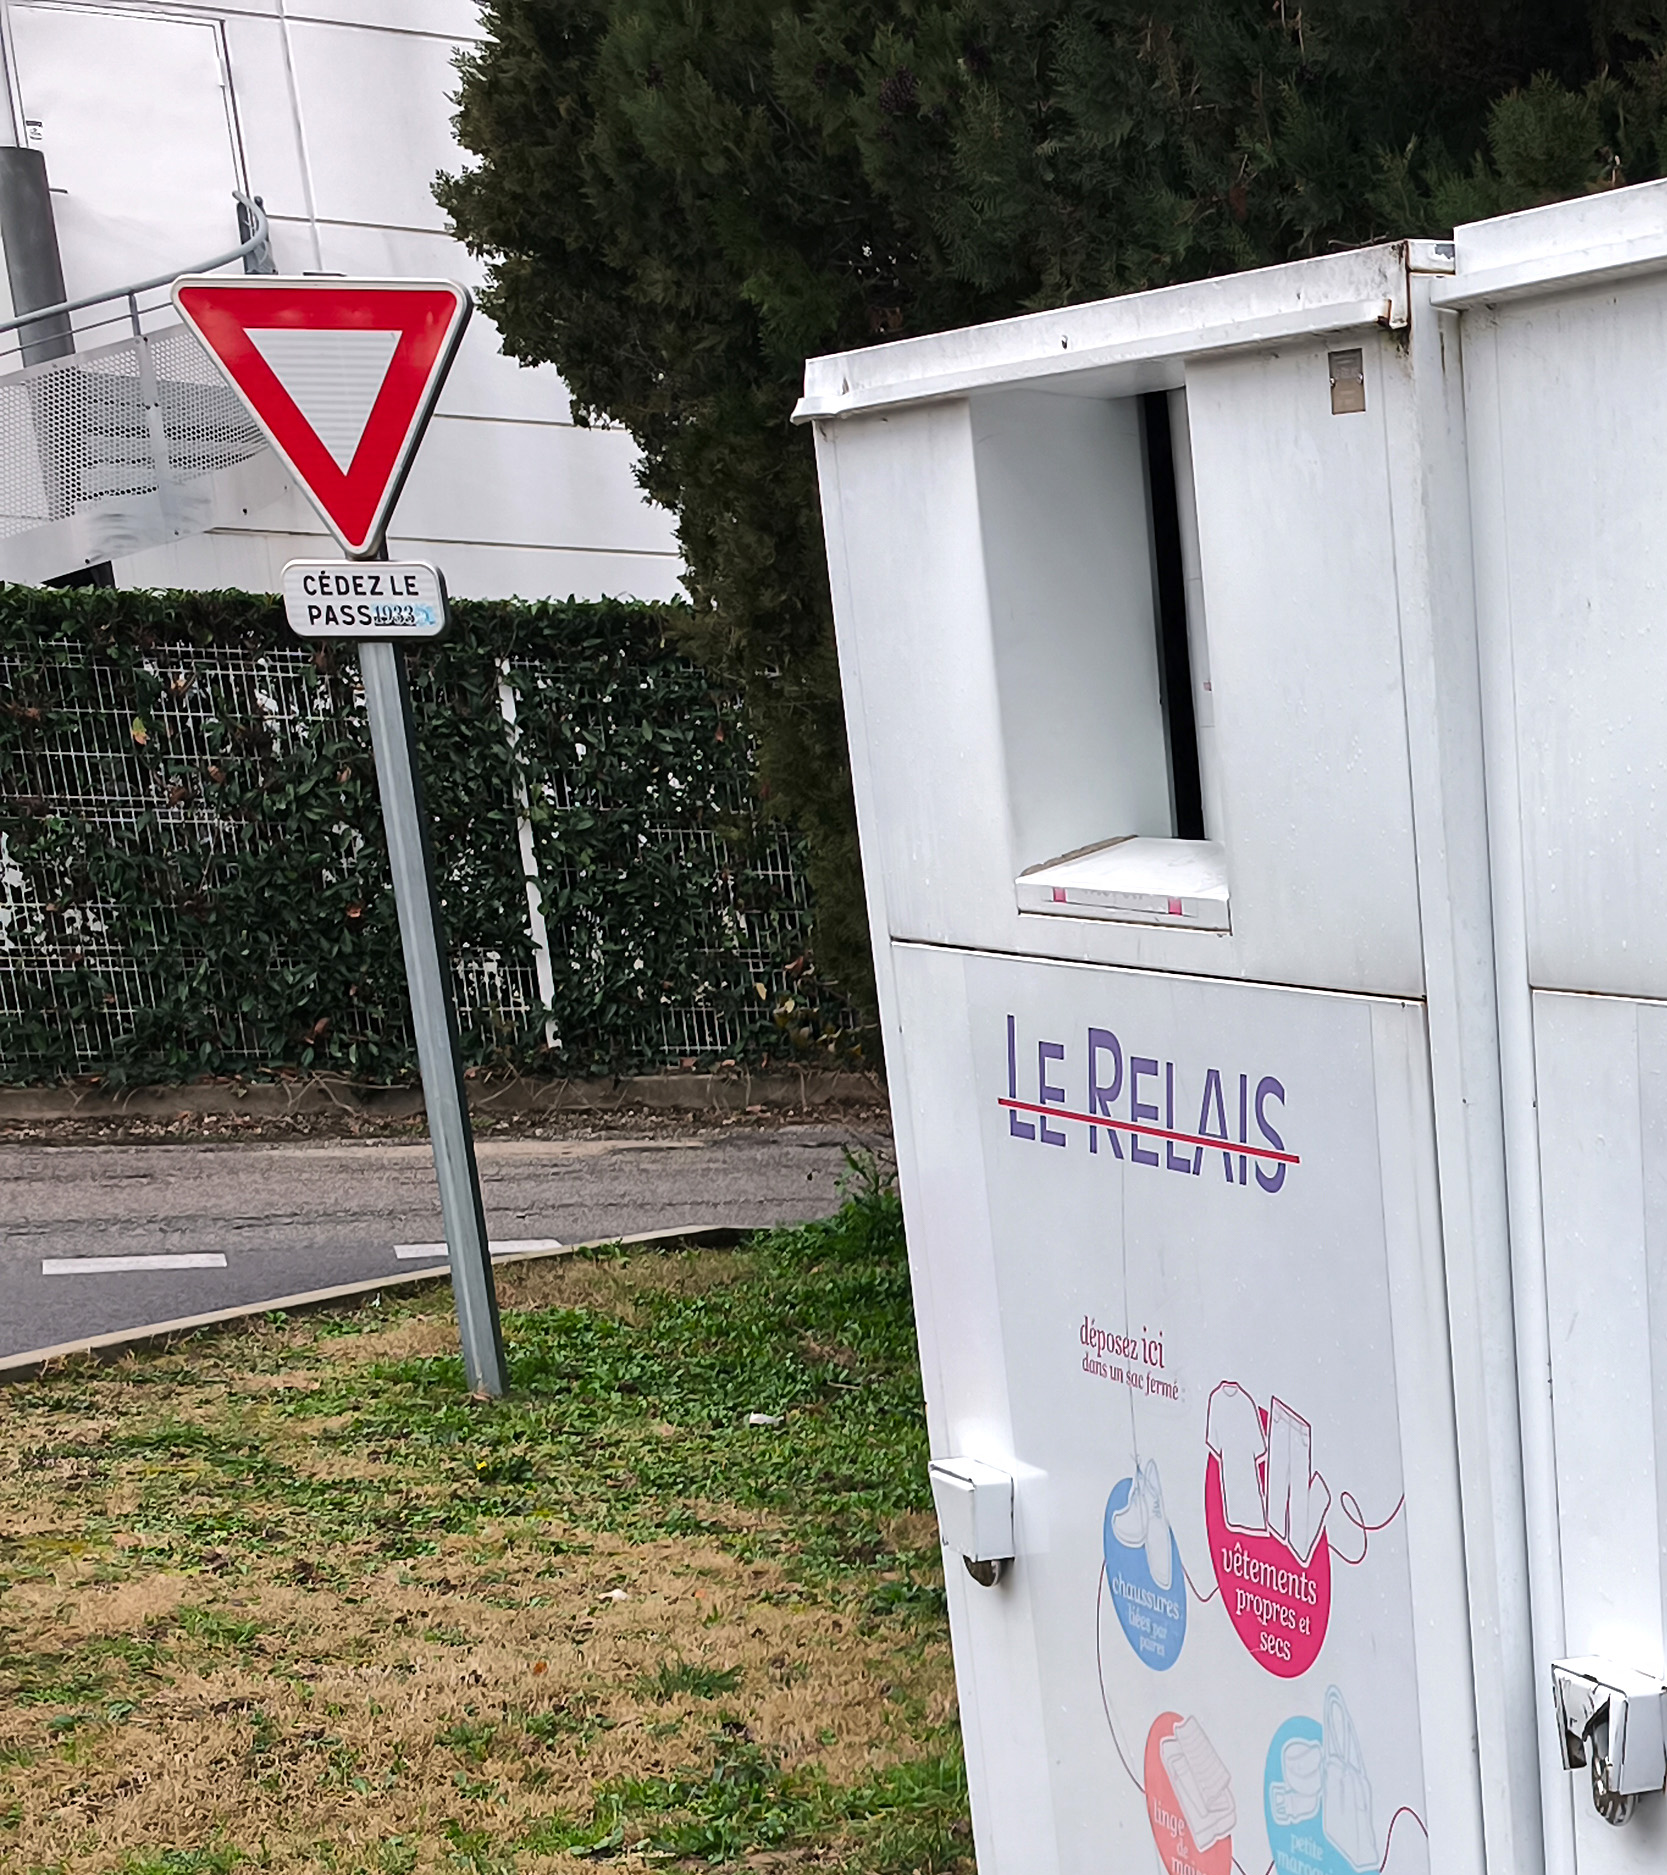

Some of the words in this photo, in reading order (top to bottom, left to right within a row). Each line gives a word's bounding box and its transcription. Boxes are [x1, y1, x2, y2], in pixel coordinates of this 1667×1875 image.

[303, 570, 384, 596] CÉDEZ
[390, 575, 419, 596] LE
[308, 604, 372, 626] PASS
[1006, 1014, 1066, 1148] LE
[1088, 1027, 1287, 1194] RELAIS
[1080, 1315, 1138, 1360] déposez
[1141, 1325, 1165, 1368] ici
[1082, 1351, 1107, 1378] dans
[1110, 1365, 1123, 1383] un
[1126, 1370, 1143, 1389] sac
[1145, 1371, 1178, 1400] fermé
[1112, 1572, 1179, 1620] chaussures
[1222, 1542, 1317, 1606] vêtements
[1235, 1587, 1295, 1630] propres
[1299, 1613, 1310, 1635] et
[1260, 1630, 1291, 1661] secs
[1154, 1801, 1185, 1838] linge
[1176, 1837, 1188, 1860] de
